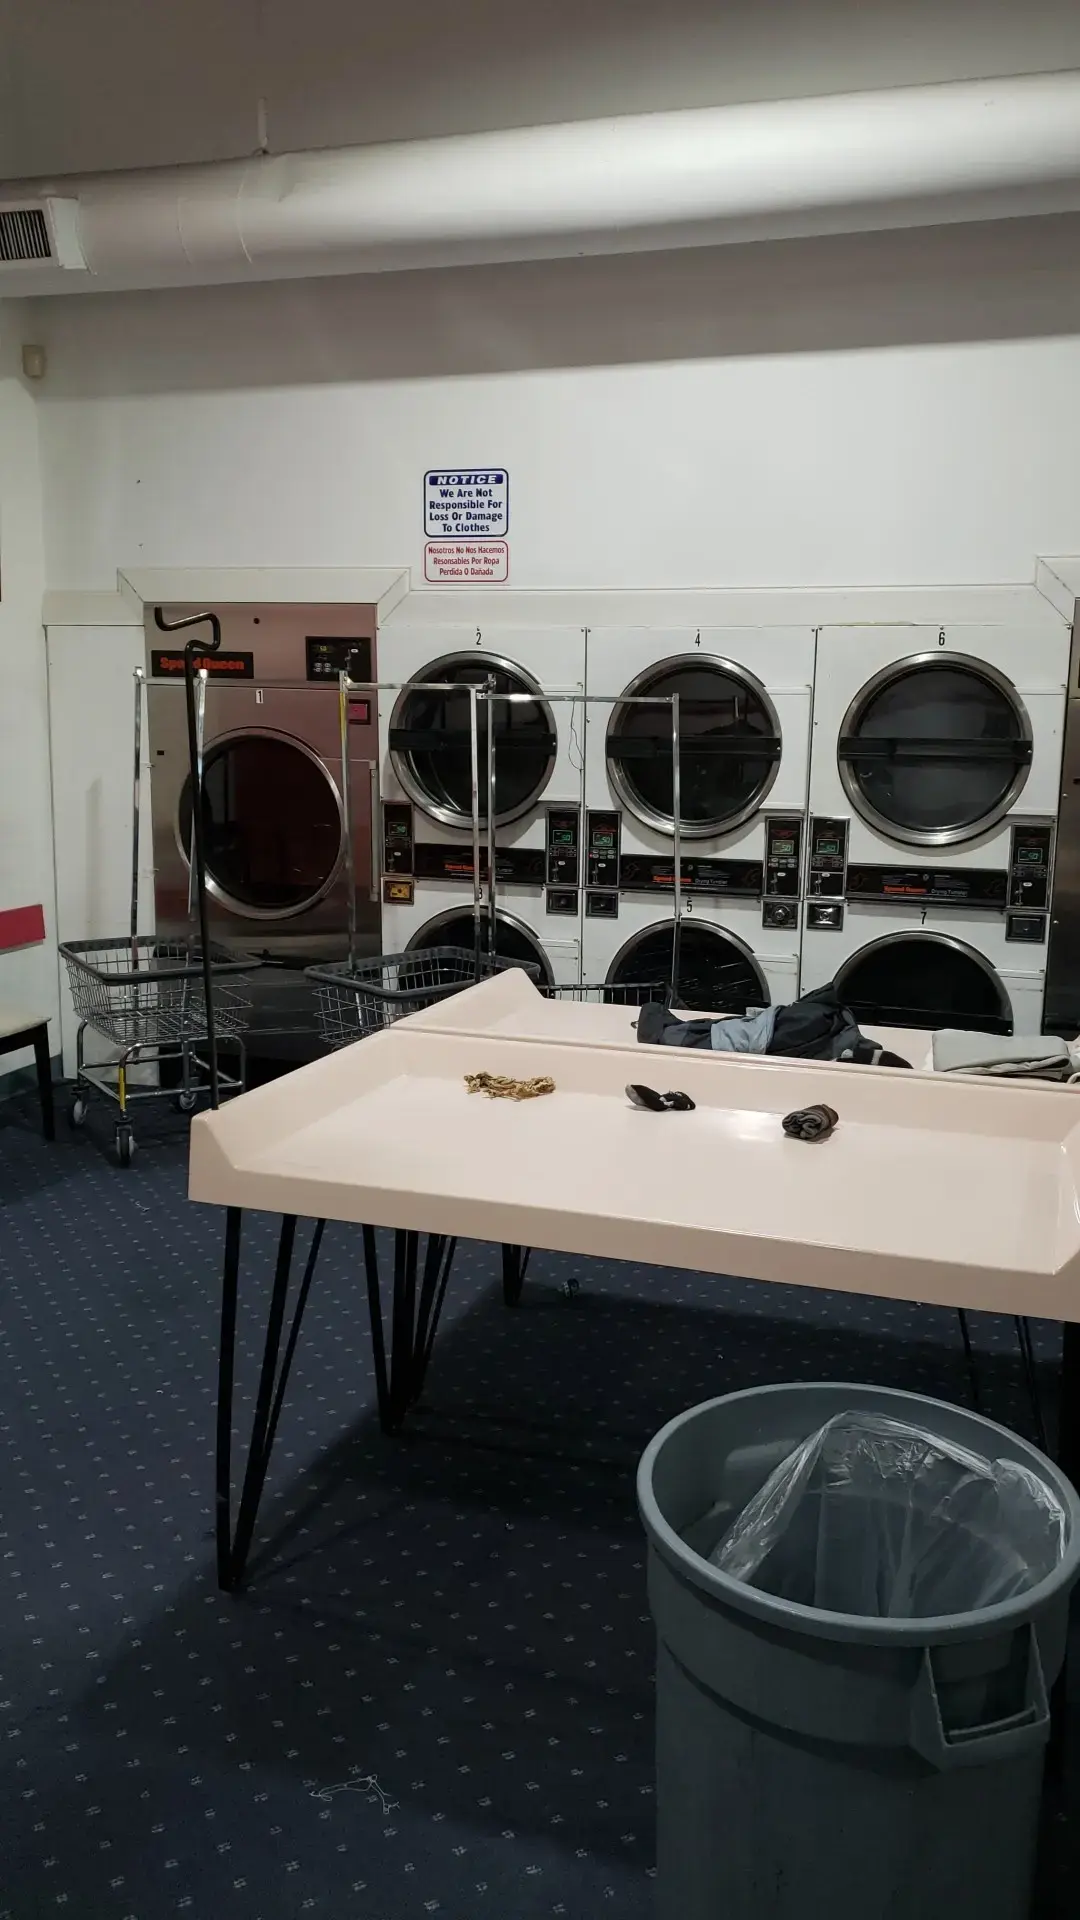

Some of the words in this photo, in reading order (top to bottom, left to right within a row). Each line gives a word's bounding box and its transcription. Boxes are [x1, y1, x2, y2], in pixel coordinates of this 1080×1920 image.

[437, 476, 496, 484] NOTICE
[440, 489, 454, 498] We
[457, 489, 473, 498] Are
[476, 488, 493, 497] Not
[429, 500, 484, 511] Responsible
[487, 500, 503, 508] For
[429, 512, 449, 521] Loss
[452, 512, 463, 521] Or
[466, 512, 503, 522] Damage
[442, 524, 452, 532] To
[455, 523, 490, 532] Clothes
[428, 546, 454, 554] Nosotros
[456, 546, 464, 554] No
[465, 546, 476, 554] Nos
[478, 546, 505, 554] Hacemos
[433, 557, 470, 565] Resonsables
[472, 557, 481, 565] Por
[484, 557, 500, 566] Ropa
[439, 568, 462, 576] Perdida
[476, 632, 482, 645] 2
[695, 632, 700, 647] 4
[938, 632, 945, 646] 6
[160, 656, 201, 671] Sped
[202, 656, 245, 670] Queen
[687, 900, 692, 912] 5
[921, 912, 927, 924] 7
